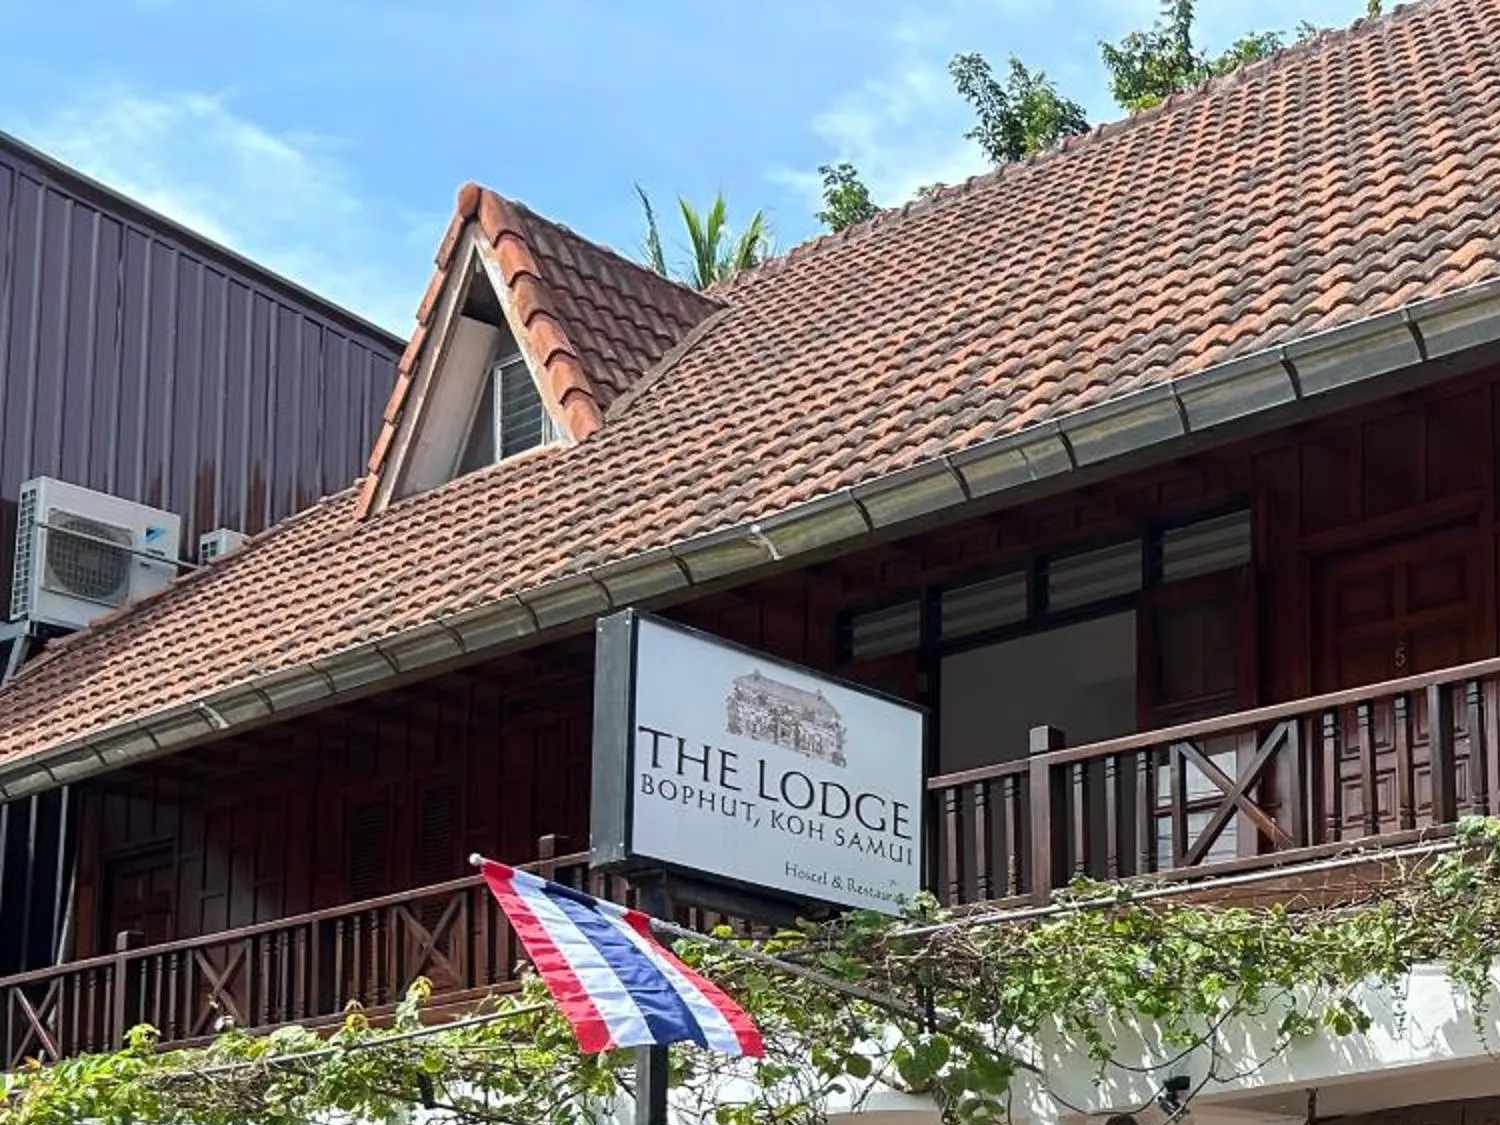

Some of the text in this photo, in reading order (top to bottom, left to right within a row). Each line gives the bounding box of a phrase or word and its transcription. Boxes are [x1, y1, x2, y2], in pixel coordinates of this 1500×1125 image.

[638, 726, 912, 841] THE LODGE
[640, 773, 913, 866] BOPHUT, KOH SAMUI
[832, 874, 844, 891] &
